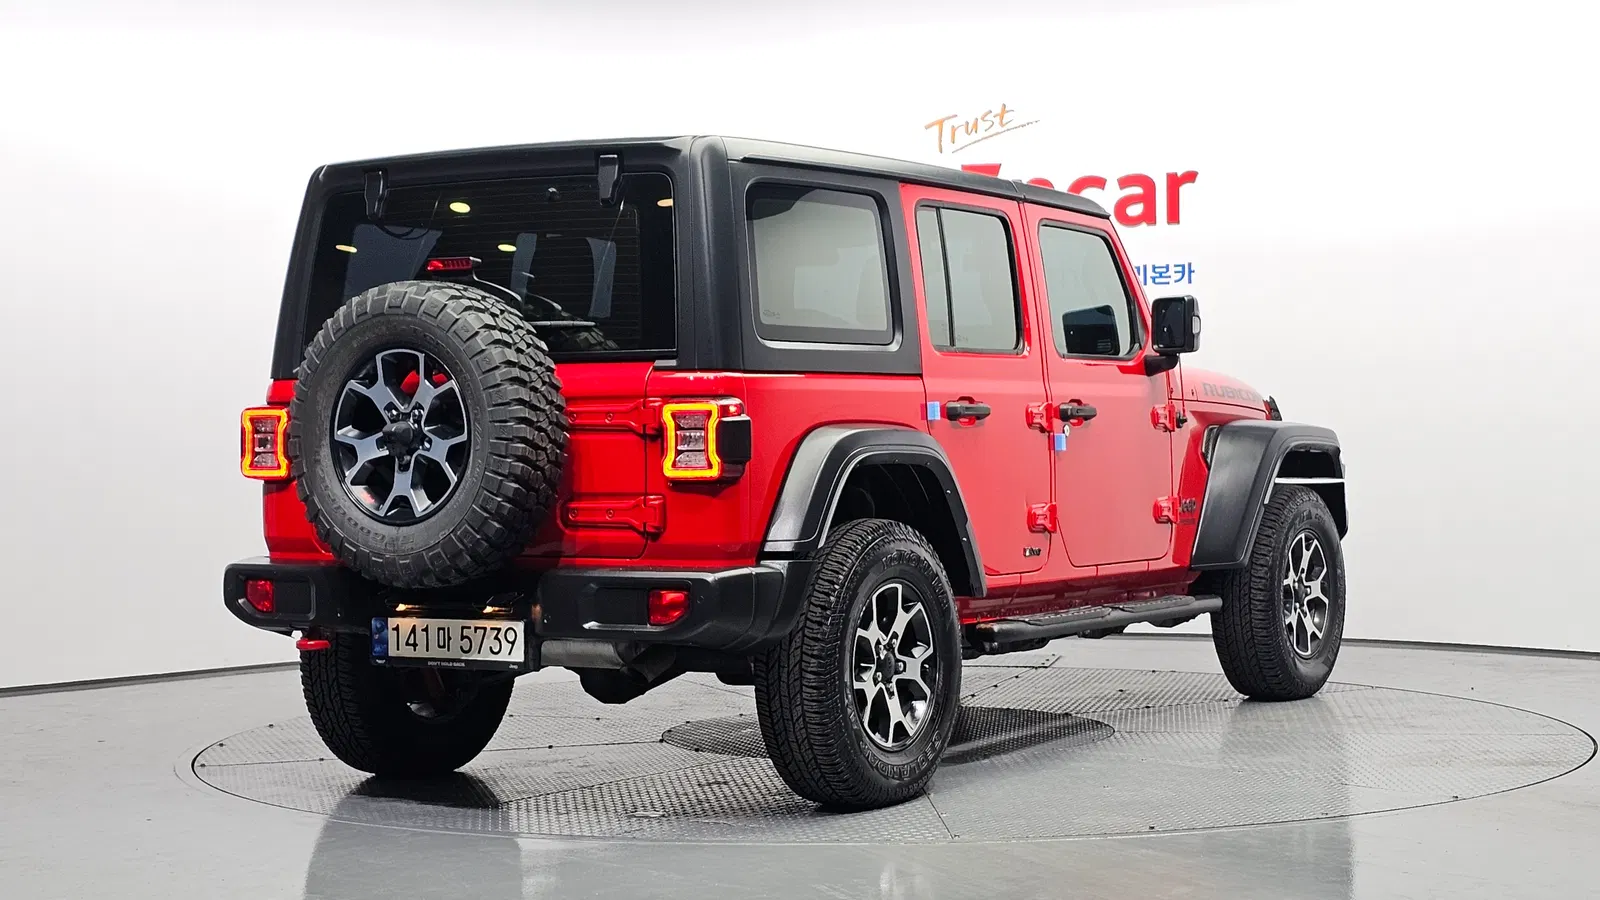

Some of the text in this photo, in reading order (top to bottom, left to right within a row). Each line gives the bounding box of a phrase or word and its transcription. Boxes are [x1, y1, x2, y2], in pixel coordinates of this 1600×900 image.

[924, 103, 1015, 154] Trust
[391, 623, 518, 656] 141마 5739
